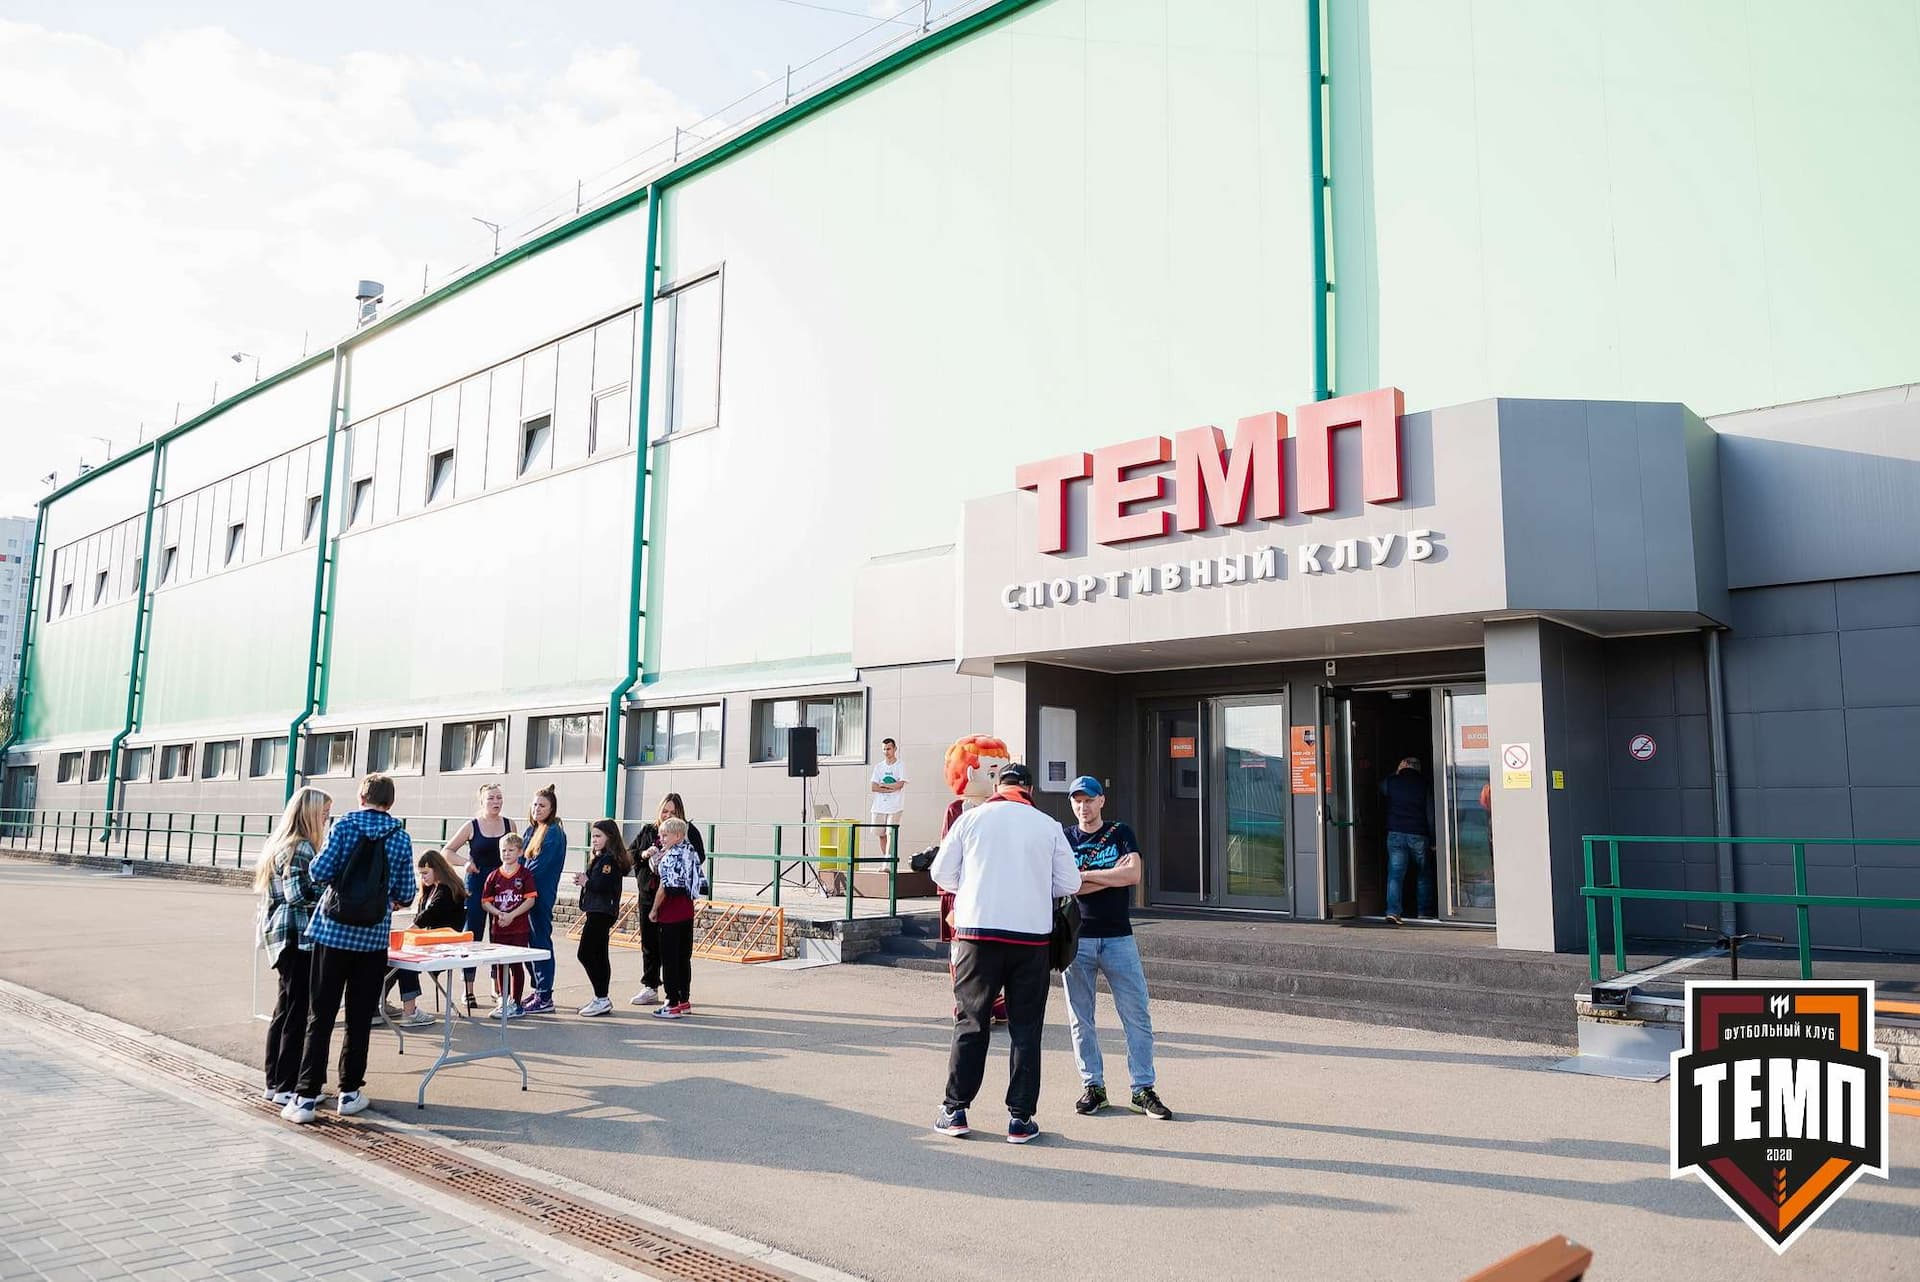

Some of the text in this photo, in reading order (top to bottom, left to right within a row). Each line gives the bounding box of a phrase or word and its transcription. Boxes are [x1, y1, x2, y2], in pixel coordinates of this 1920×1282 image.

[1016, 386, 1404, 554] ТЕМП
[1001, 529, 1435, 610] СПОРТИВНЫЙ КЛУБ
